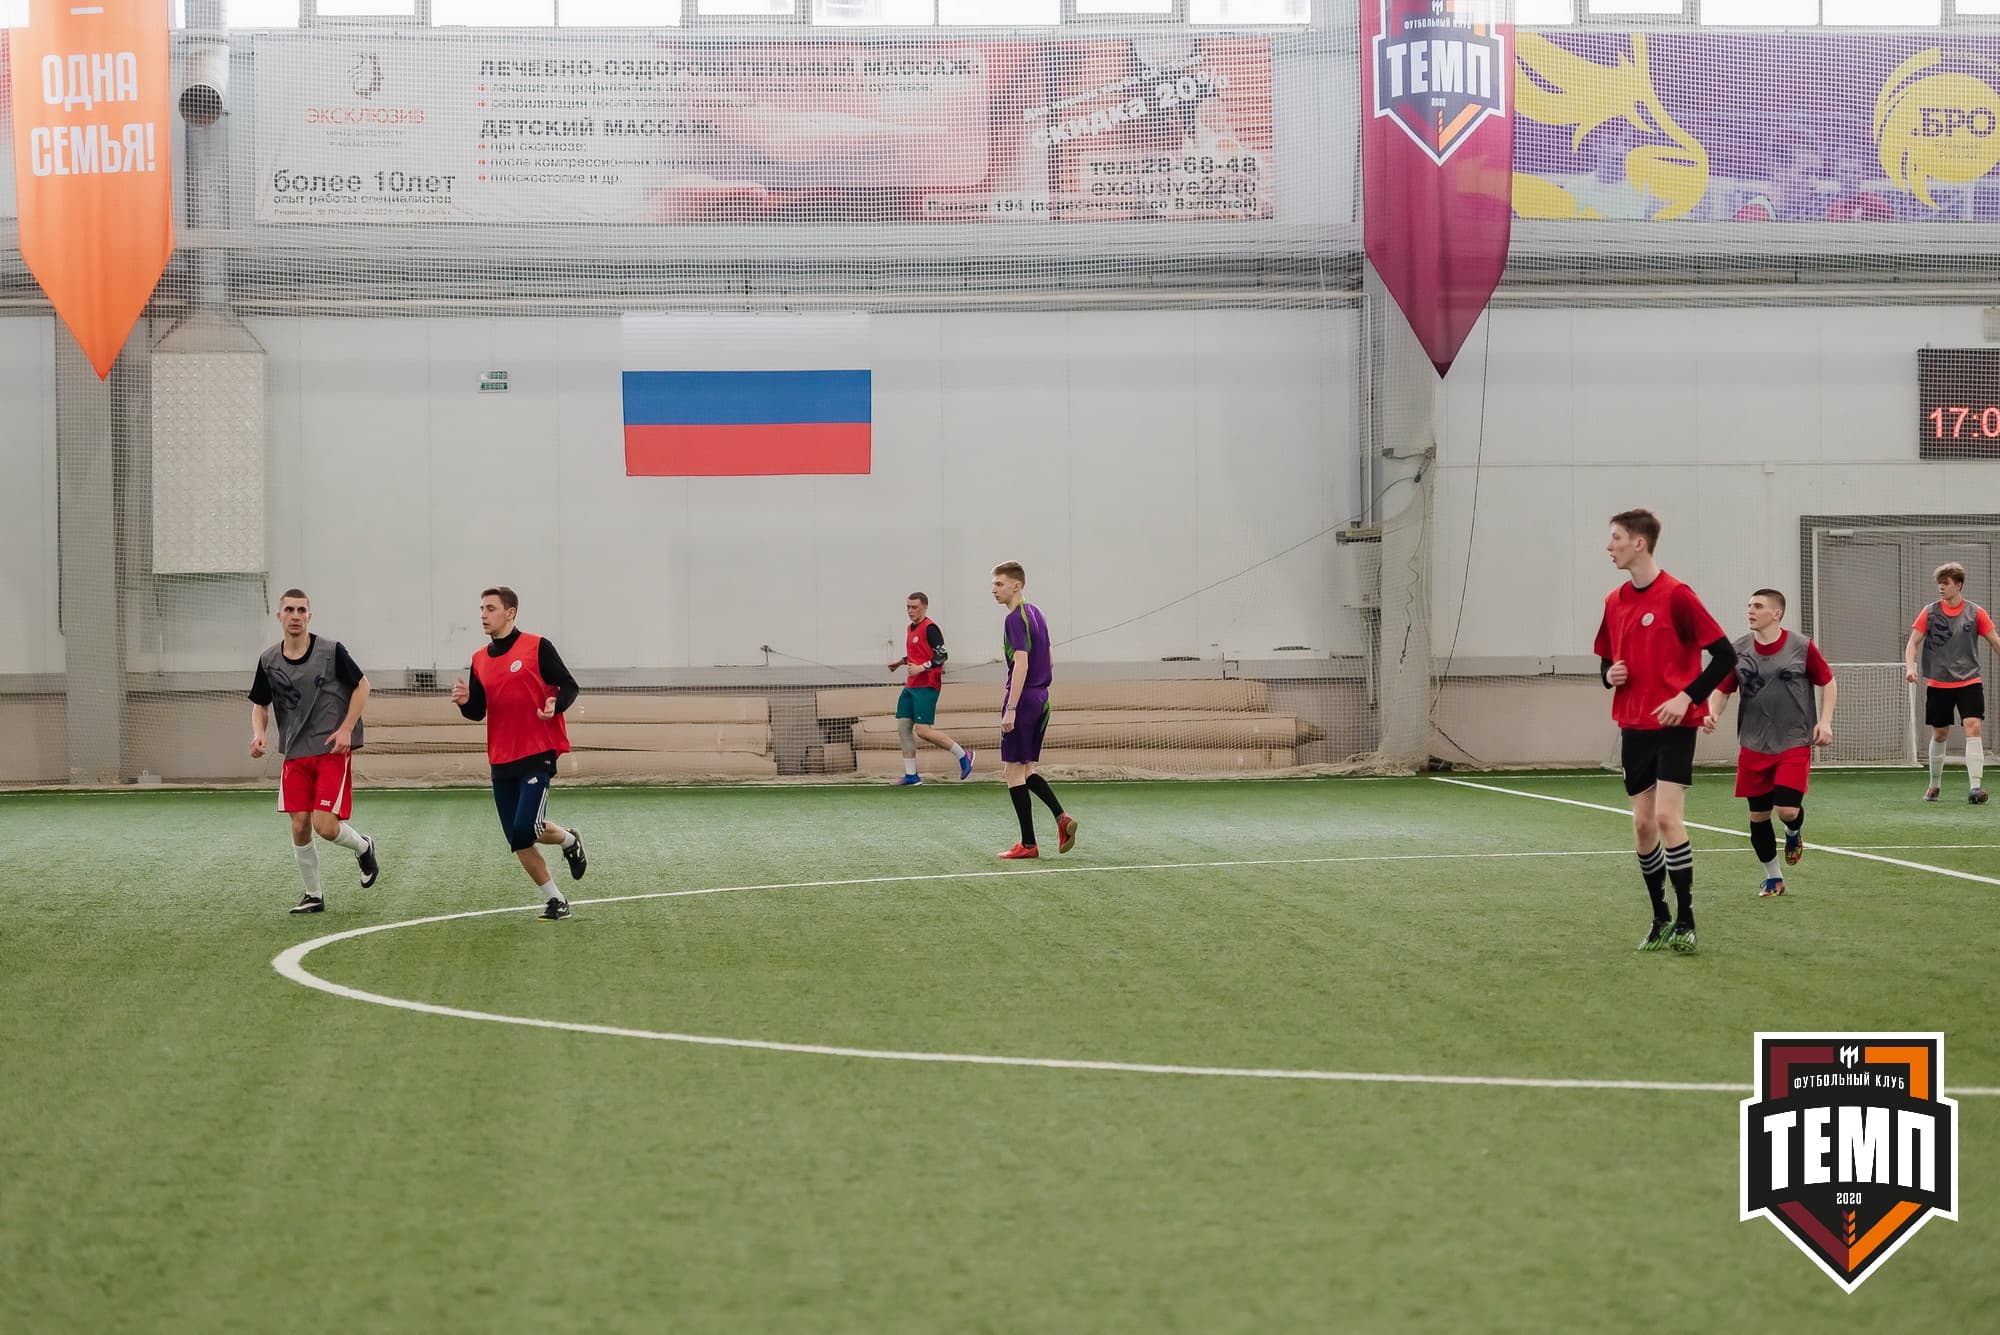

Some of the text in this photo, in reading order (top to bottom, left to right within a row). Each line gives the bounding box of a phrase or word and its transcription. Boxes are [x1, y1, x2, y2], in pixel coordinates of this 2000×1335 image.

[1404, 17, 1450, 29] ФУТБОЛЬНЫЙ
[480, 57, 980, 79] ЛЕЧЕБНО-ОЗДОРОВИТЕЛЬНЫЙ МАССАЖ:
[1386, 40, 1490, 98] ТЕМП
[42, 52, 138, 112] ОДНА
[1155, 66, 1229, 108] 20%
[306, 108, 424, 123] ЭКСКЛЮЗИВ
[482, 115, 721, 138] ДЕТСКИЙ МАССАЖ:
[31, 123, 155, 176] СЕМЬЯ!
[491, 144, 515, 153] при
[491, 159, 529, 168] после
[274, 169, 456, 192] более 10лет
[273, 192, 452, 206] опыт работы специалистов
[995, 199, 1023, 212] 194
